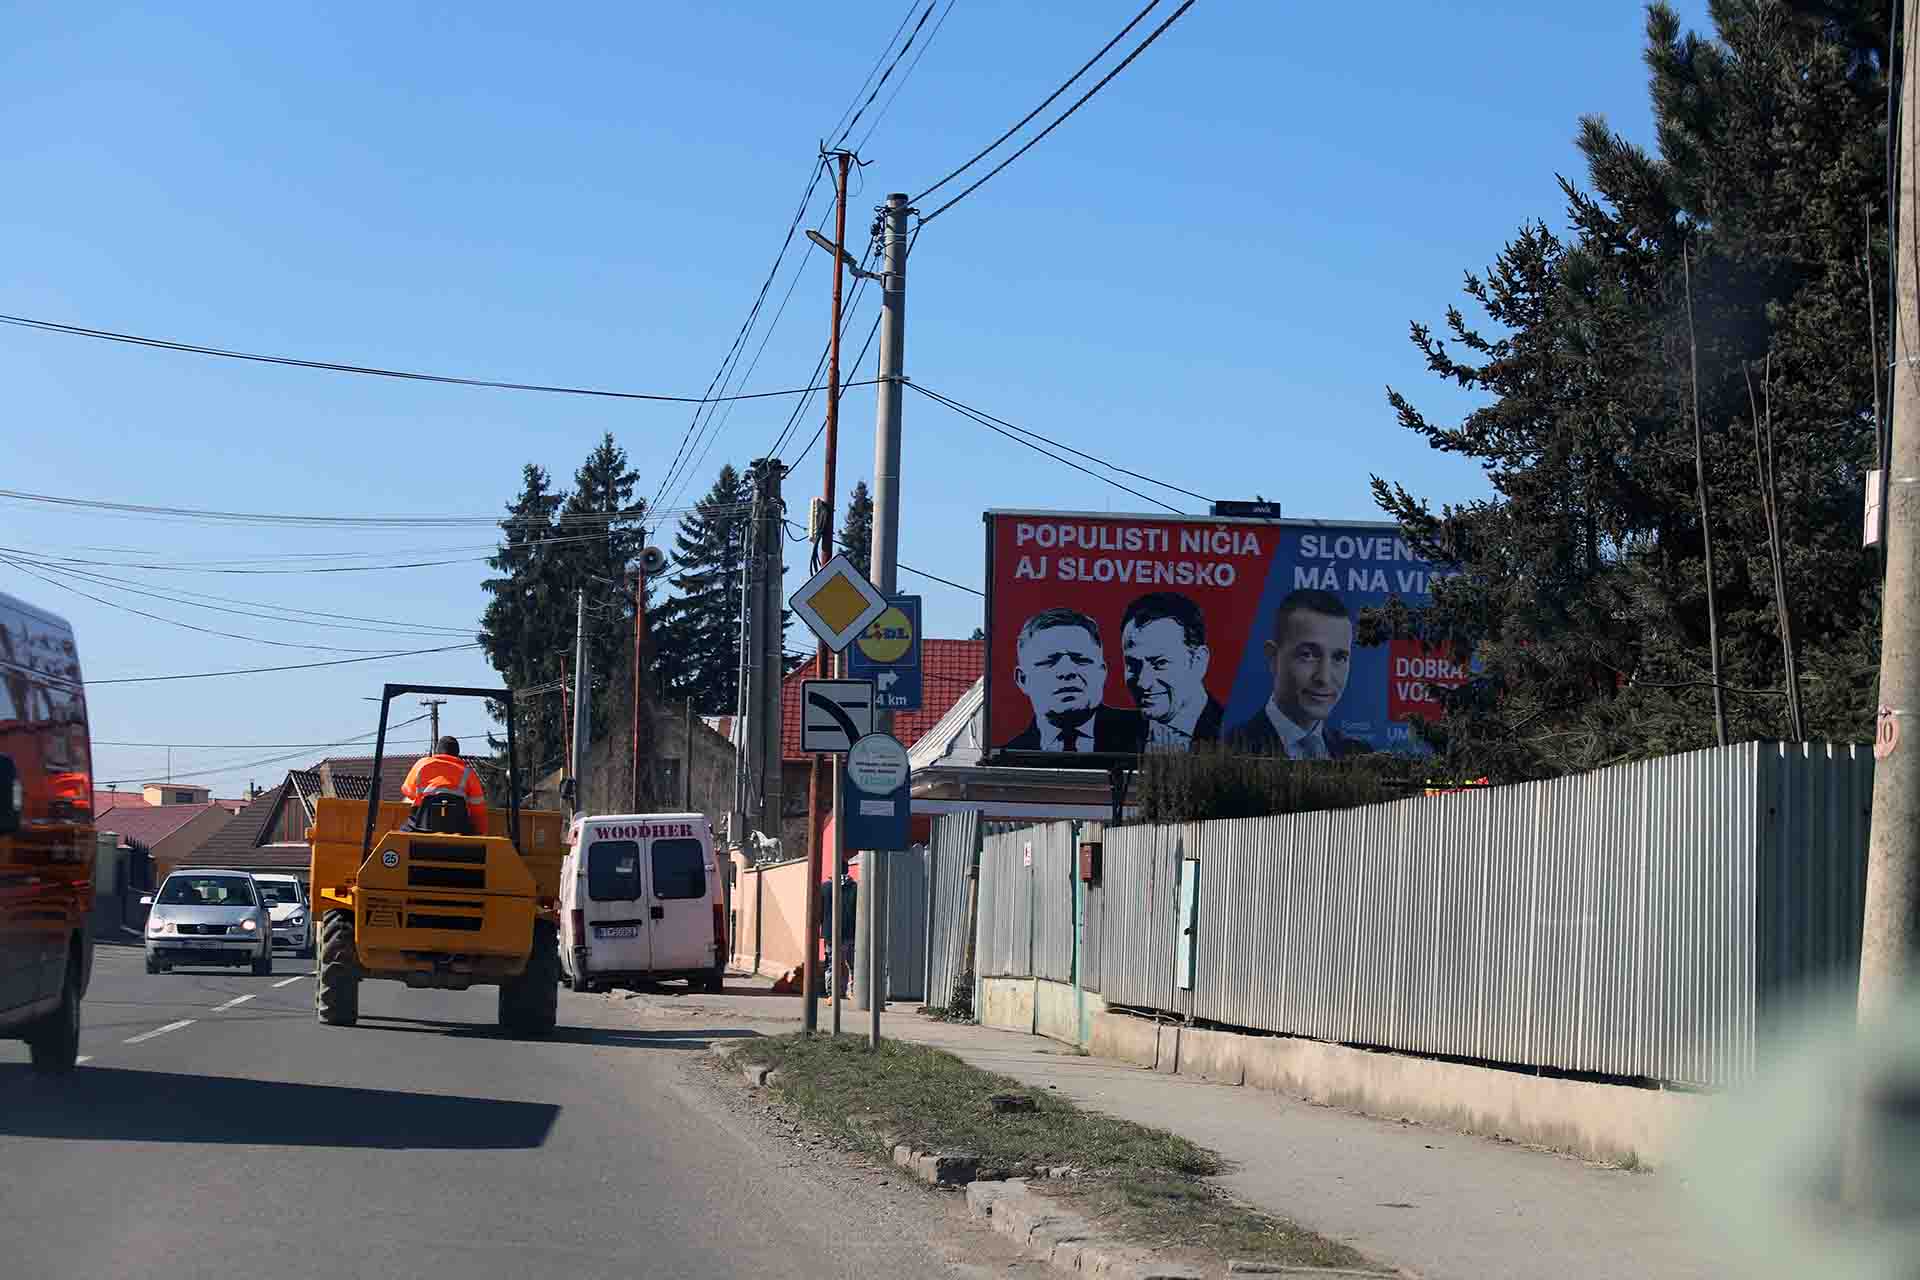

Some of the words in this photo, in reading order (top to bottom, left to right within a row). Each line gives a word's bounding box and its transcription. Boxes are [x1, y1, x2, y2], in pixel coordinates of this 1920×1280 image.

[1016, 523, 1169, 553] POPULISTI
[1180, 524, 1262, 556] NIČIA
[1015, 555, 1048, 580] AJ
[1057, 558, 1237, 587] SLOVENSKO
[1293, 561, 1340, 591] MÁ
[1347, 567, 1390, 593] NA
[888, 693, 906, 705] km
[385, 853, 397, 863] 25
